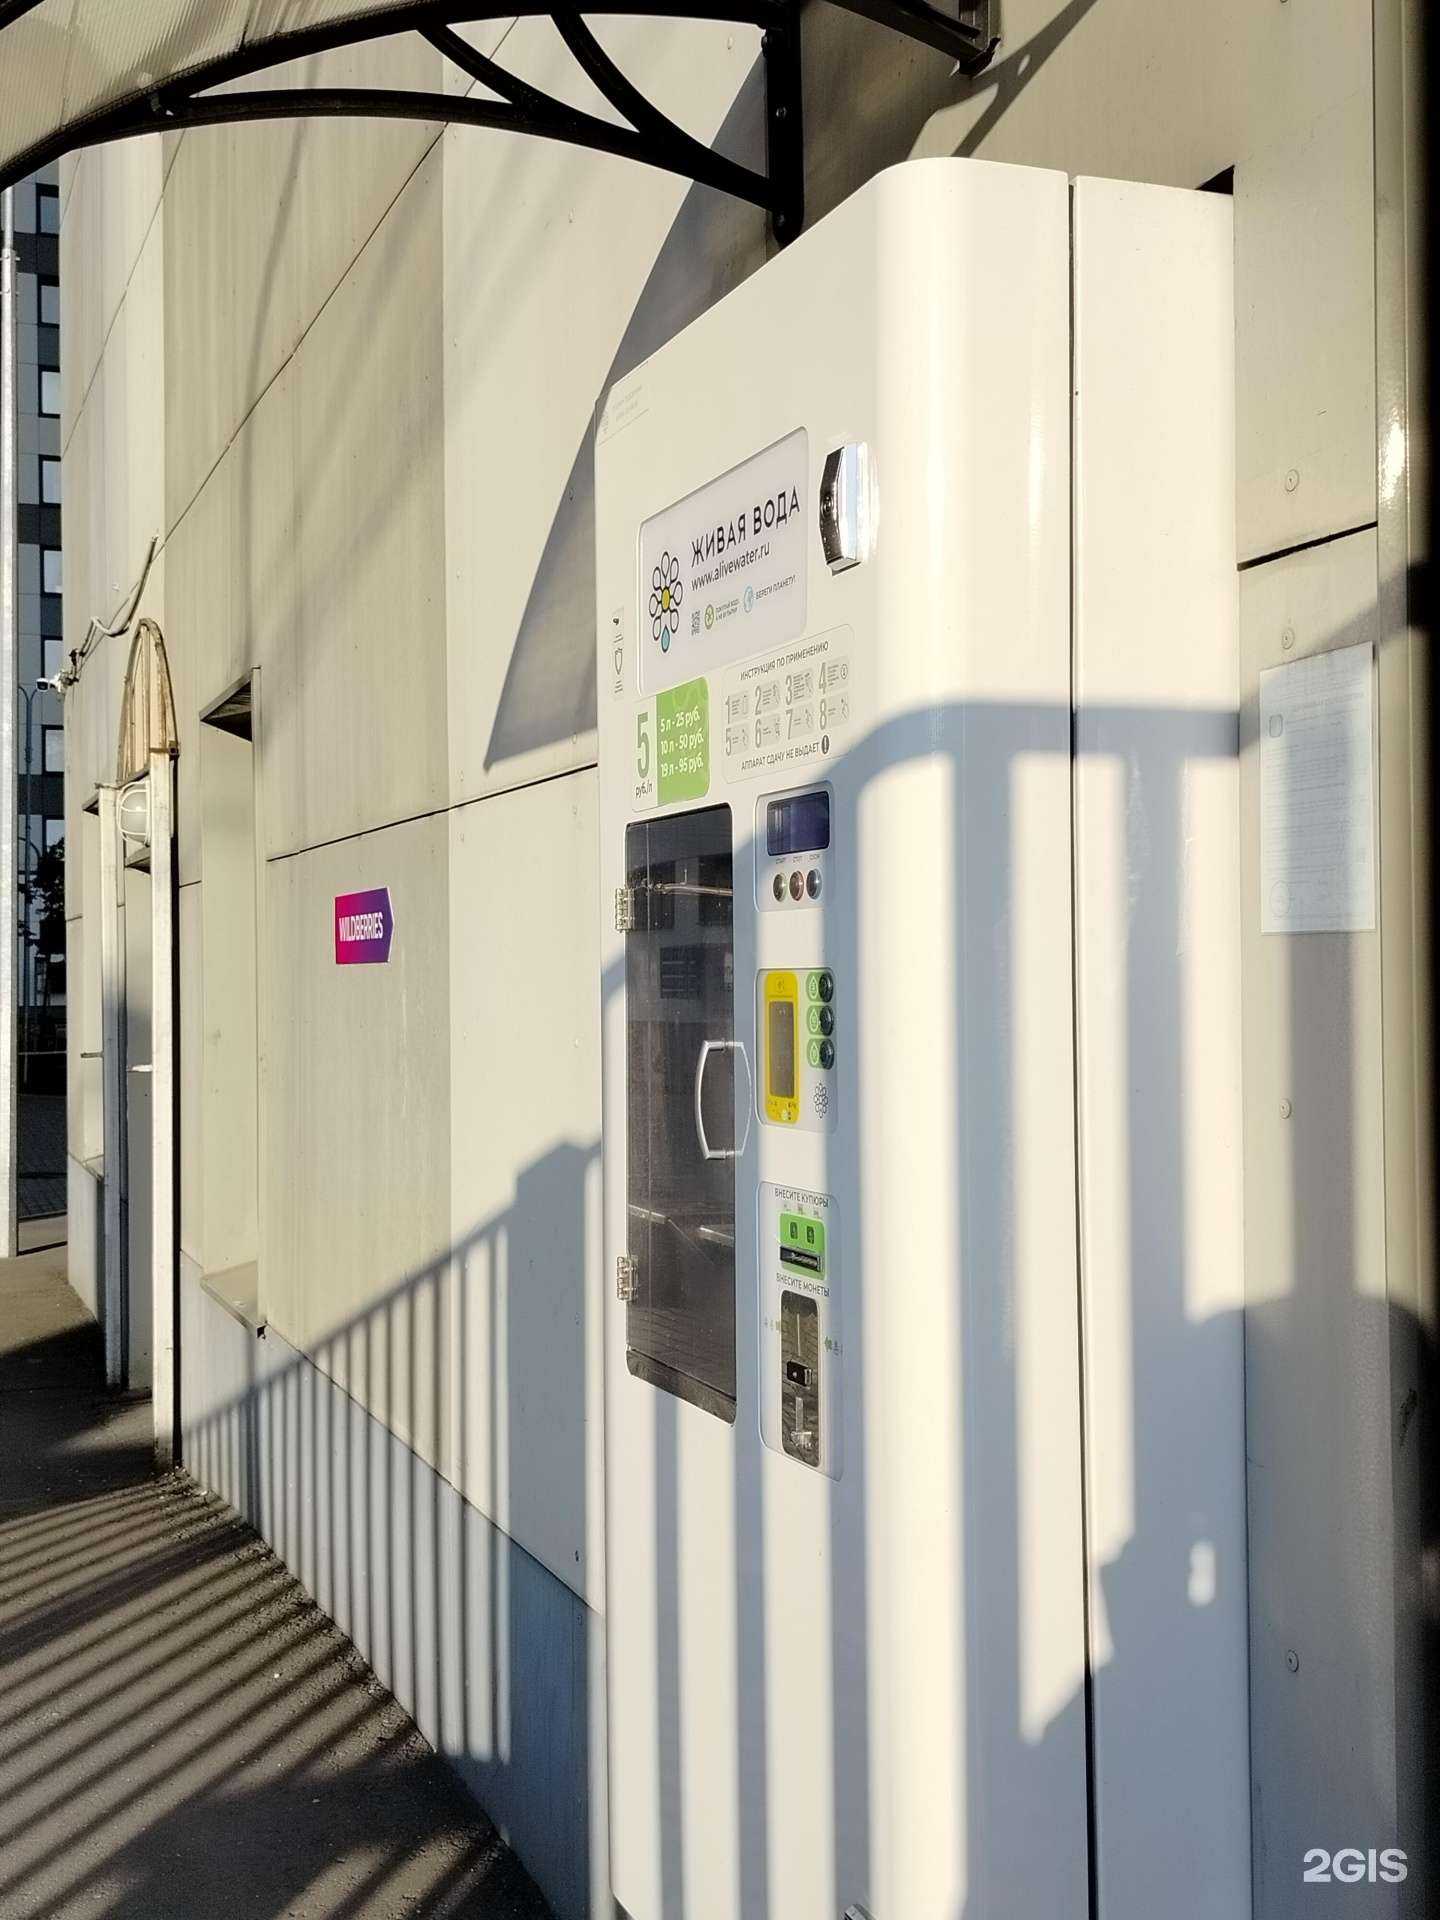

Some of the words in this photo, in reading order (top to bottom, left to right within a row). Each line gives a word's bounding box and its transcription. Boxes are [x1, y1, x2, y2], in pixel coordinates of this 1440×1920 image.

[691, 513, 746, 569] ЖИВАЯ
[753, 485, 801, 536] ВОДА
[691, 542, 770, 591] www.alivewater.ru
[740, 660, 776, 681] ИНСТРУКЦИЯ
[776, 657, 786, 669] ПО
[785, 640, 829, 664] ПРИМЕНЕНИЮ
[785, 674, 793, 706] 3
[818, 661, 827, 695] 4
[725, 695, 730, 724] 1
[755, 685, 762, 716] 2
[819, 698, 827, 730] 8
[660, 718, 665, 733] 5
[665, 719, 671, 732] л
[675, 711, 685, 728] 25
[755, 718, 762, 749] 6
[785, 708, 793, 741] 7
[637, 711, 650, 779] 5
[660, 740, 669, 756] 10
[669, 740, 675, 753] л
[679, 733, 688, 750] 50
[725, 727, 732, 757] 5
[741, 756, 766, 770] АППАРАТ
[766, 751, 785, 765] СДАЧУ
[785, 748, 794, 760] НЕ
[794, 742, 820, 758] ВЫДАЕТ
[660, 762, 669, 778] 19
[668, 763, 675, 777] л
[678, 757, 688, 773] 95
[338, 911, 384, 942] WILDBERRIES
[774, 1187, 801, 1202] ВНЕСИТЕ
[801, 1192, 829, 1208] КУПЮРЫ
[776, 1272, 802, 1290] ВНЕСИТЕ
[803, 1281, 830, 1298] МОНЕТЫ
